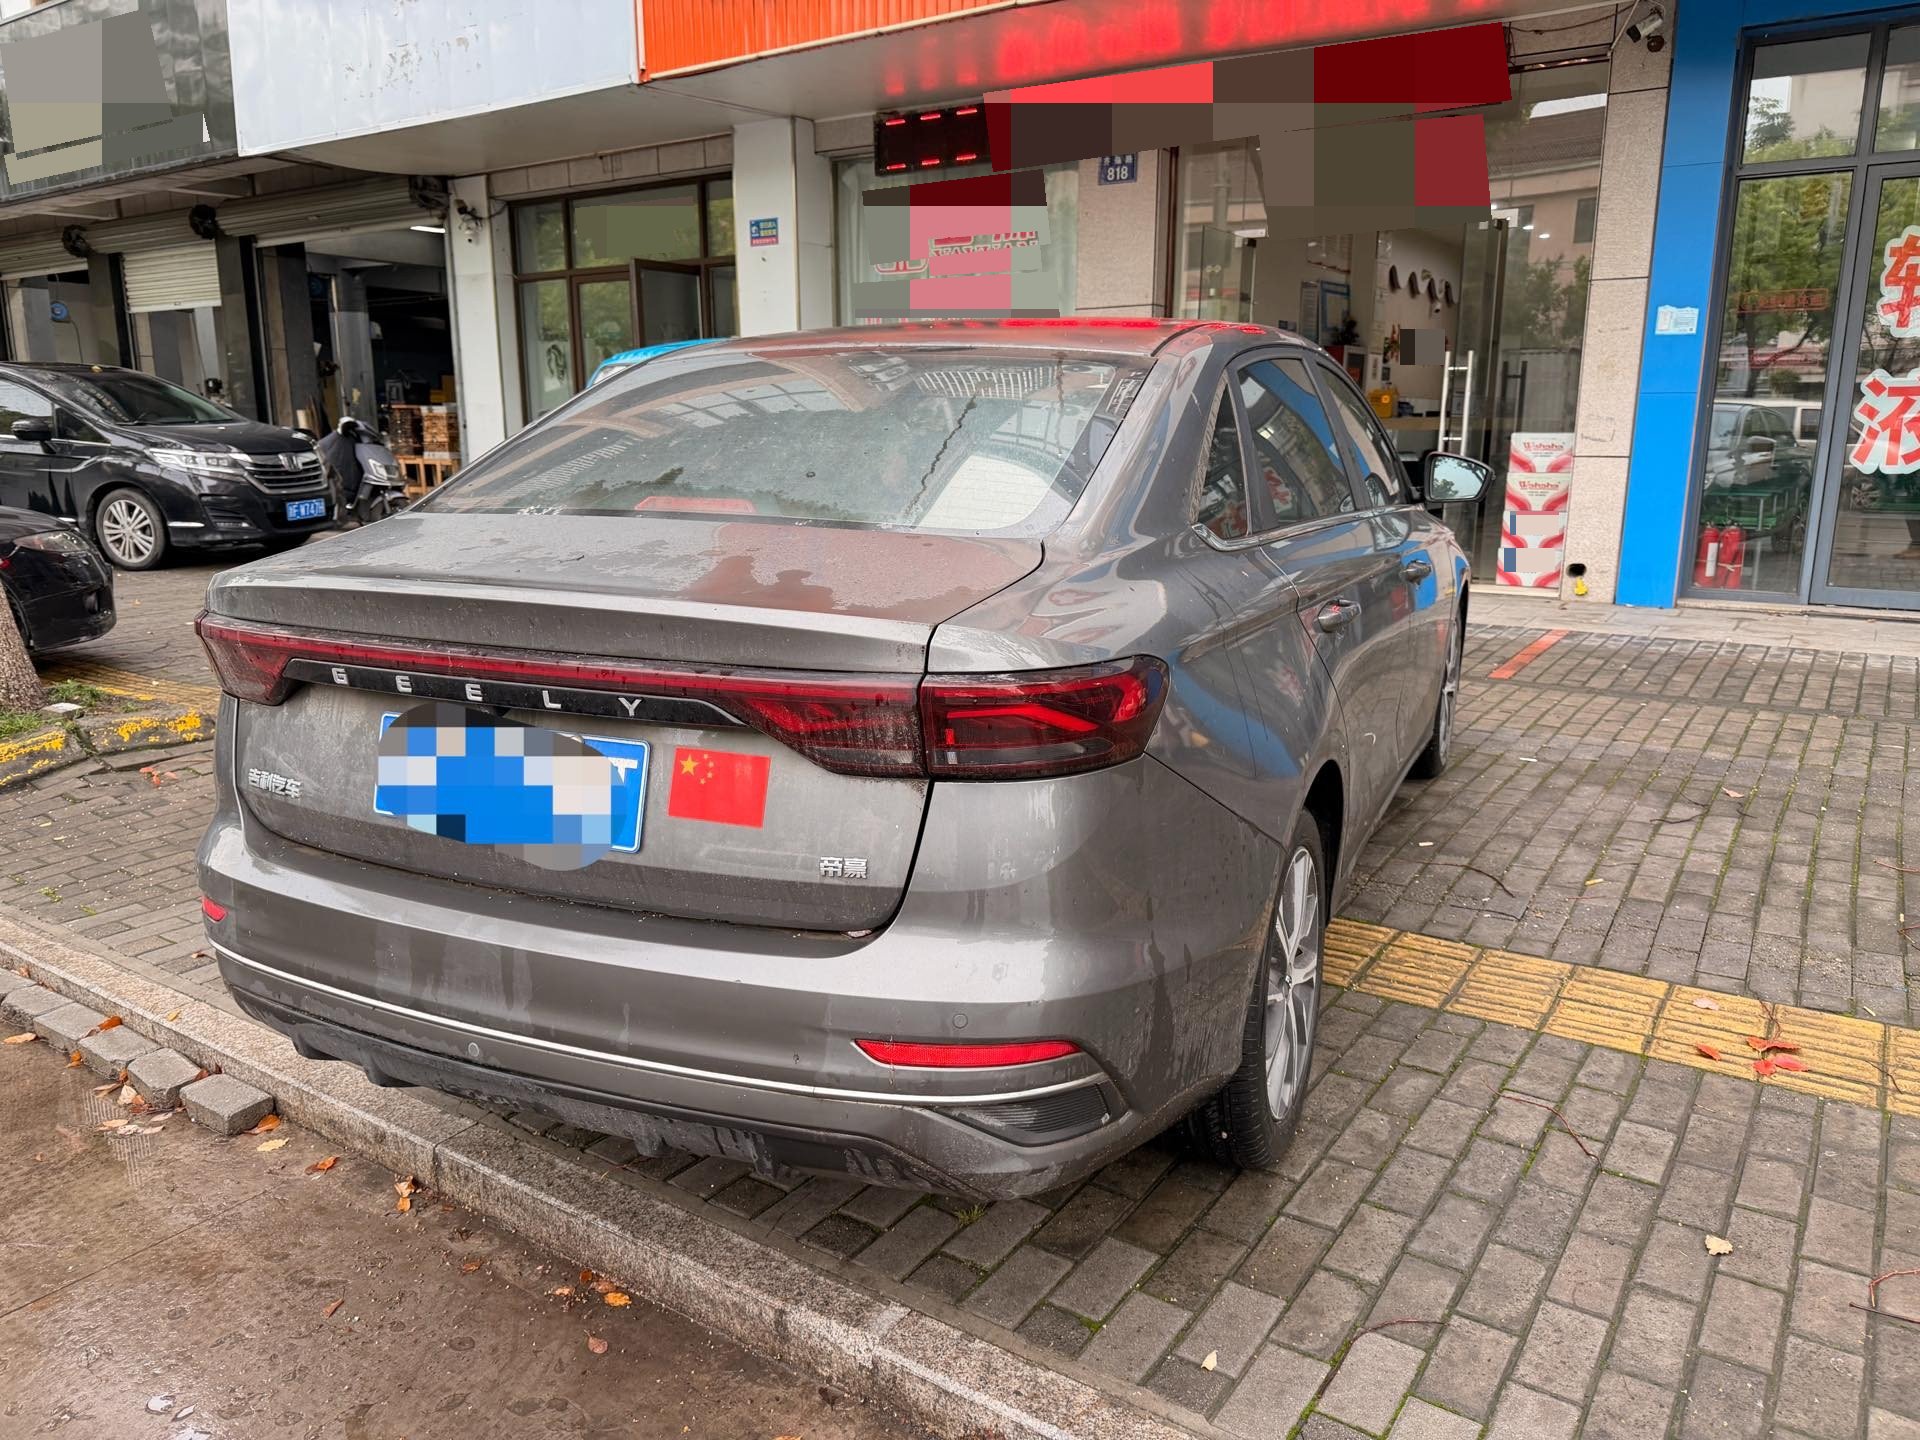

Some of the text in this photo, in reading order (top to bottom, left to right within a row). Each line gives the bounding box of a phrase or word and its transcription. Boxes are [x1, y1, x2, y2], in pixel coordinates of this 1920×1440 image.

[1107, 166, 1128, 180] 818
[331, 667, 642, 717] GEELY
[248, 768, 301, 798] 吉利汽车
[820, 857, 867, 879] 帝豪
